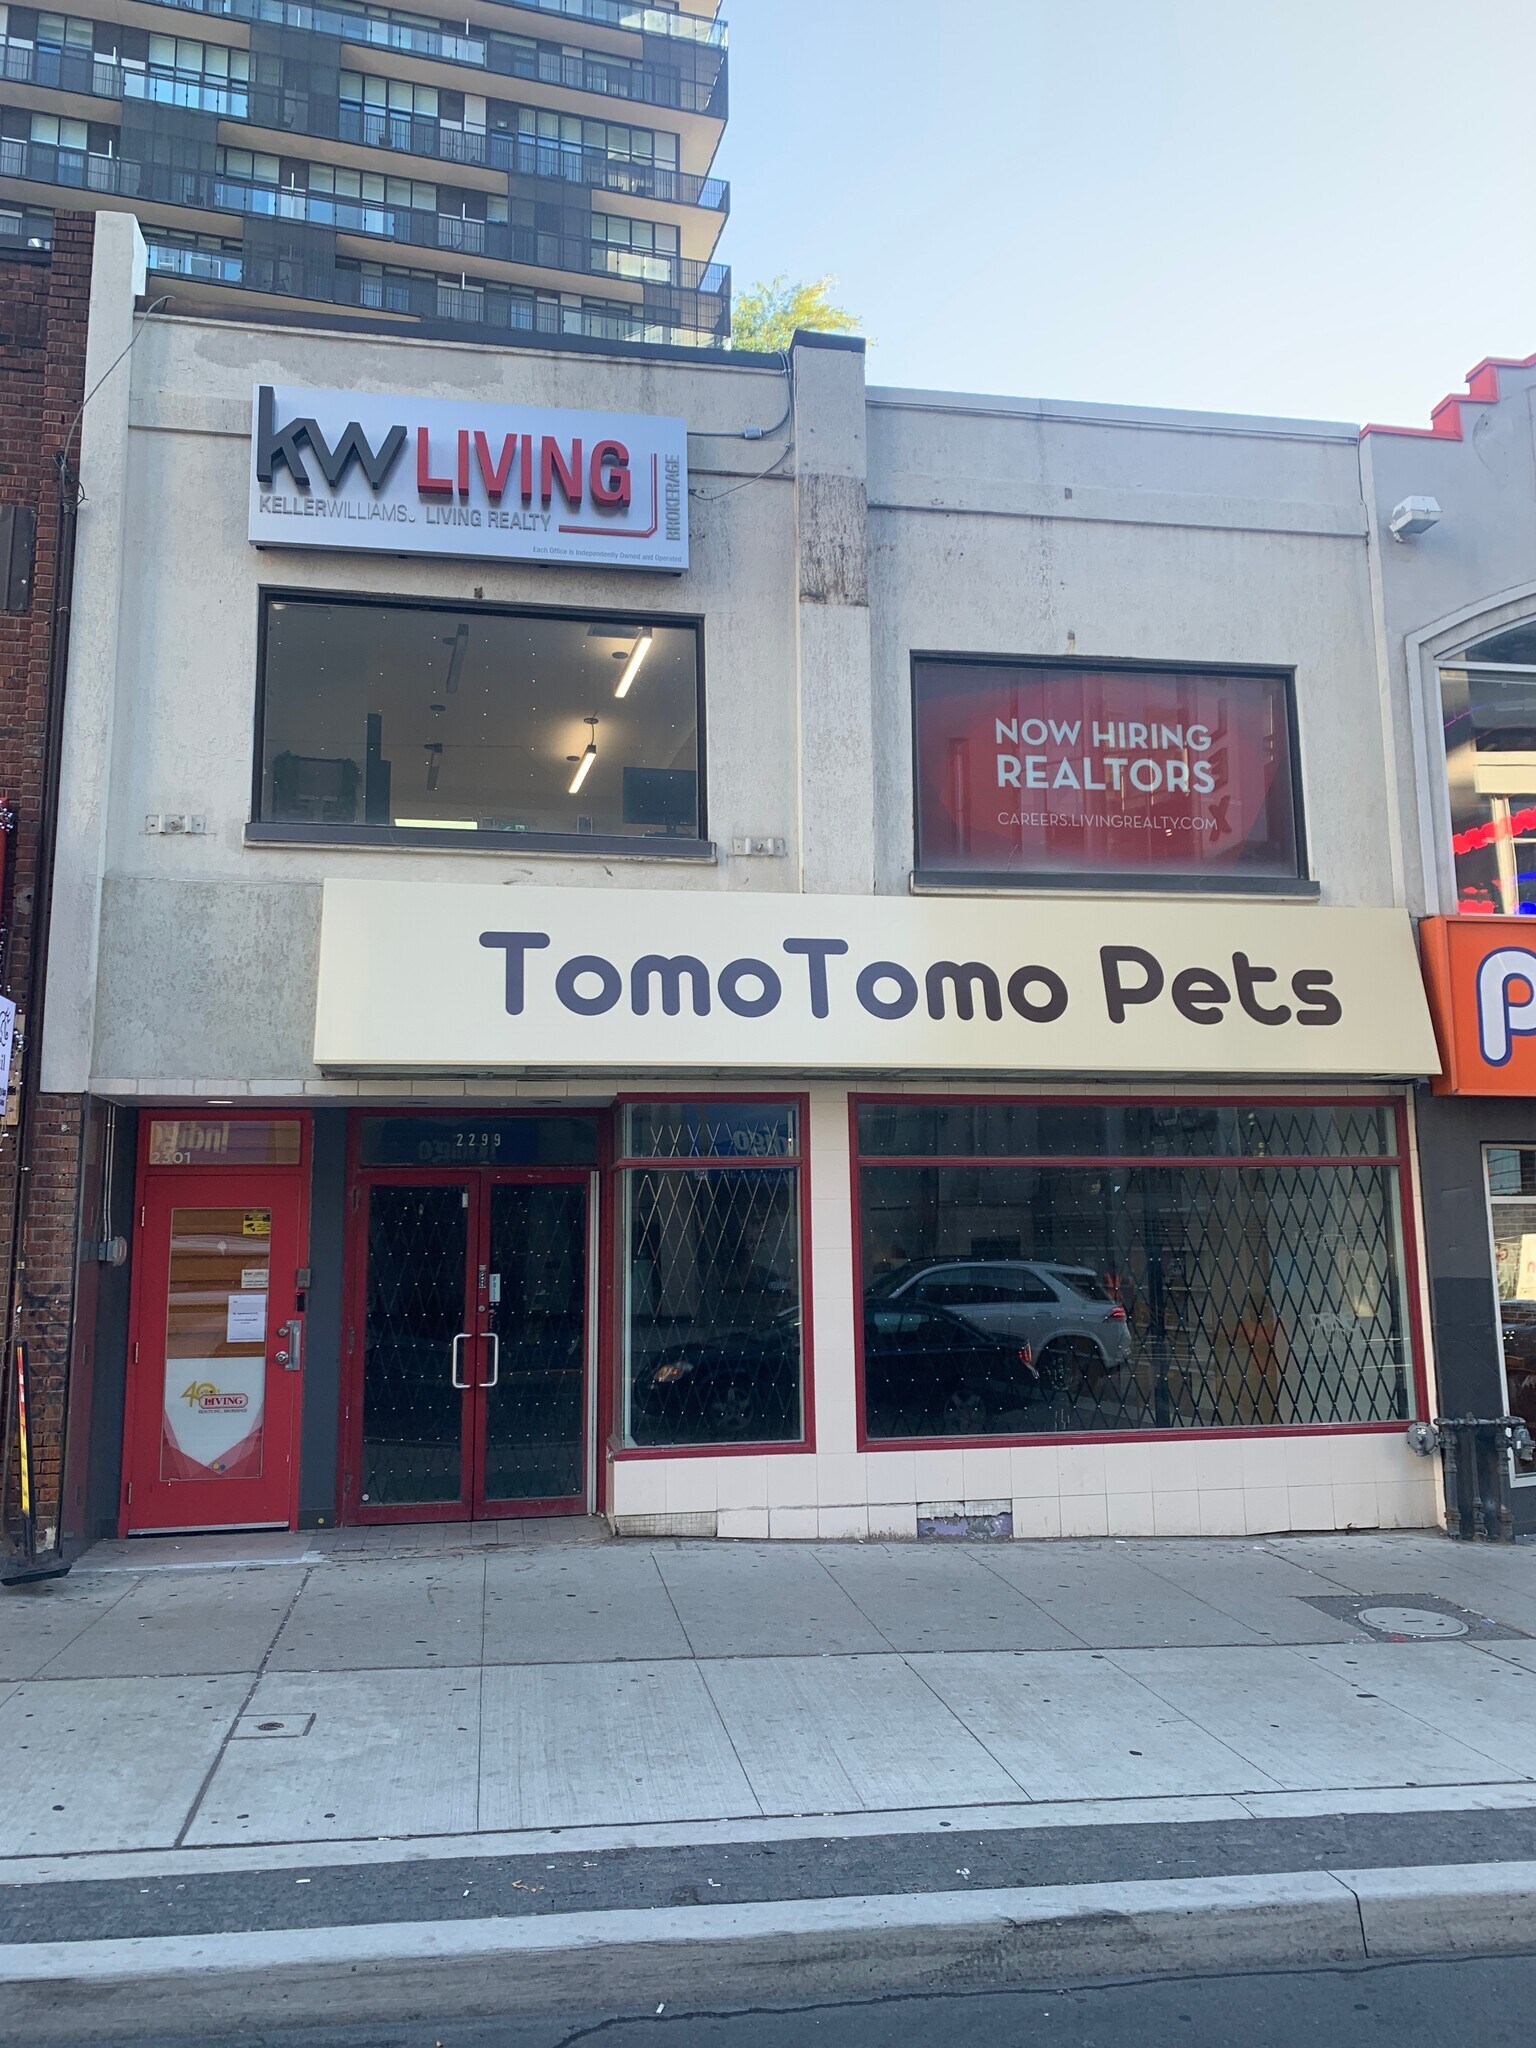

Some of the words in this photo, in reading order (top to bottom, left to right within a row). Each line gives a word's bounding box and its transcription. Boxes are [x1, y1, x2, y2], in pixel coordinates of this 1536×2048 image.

[417, 426, 631, 508] LIVING
[665, 454, 680, 540] BROKERAGE
[426, 506, 482, 527] LIVING
[488, 511, 551, 532] REALTY
[533, 546, 548, 554] Each
[549, 547, 567, 556] Office
[576, 550, 618, 559] Independently
[620, 552, 640, 560] Owned
[655, 555, 682, 563] Operated
[995, 718, 1082, 747] NOW
[1092, 720, 1213, 751] HIRING
[996, 754, 1216, 794] REALTORS
[997, 811, 1218, 831] CAREERS.LIVINGREALTY.COM
[479, 931, 1069, 1025] TomoTomo
[1099, 945, 1343, 1027] Pets
[456, 1133, 501, 1147] 2299
[152, 1152, 191, 1164] 2301
[204, 1396, 243, 1406] LIVING
